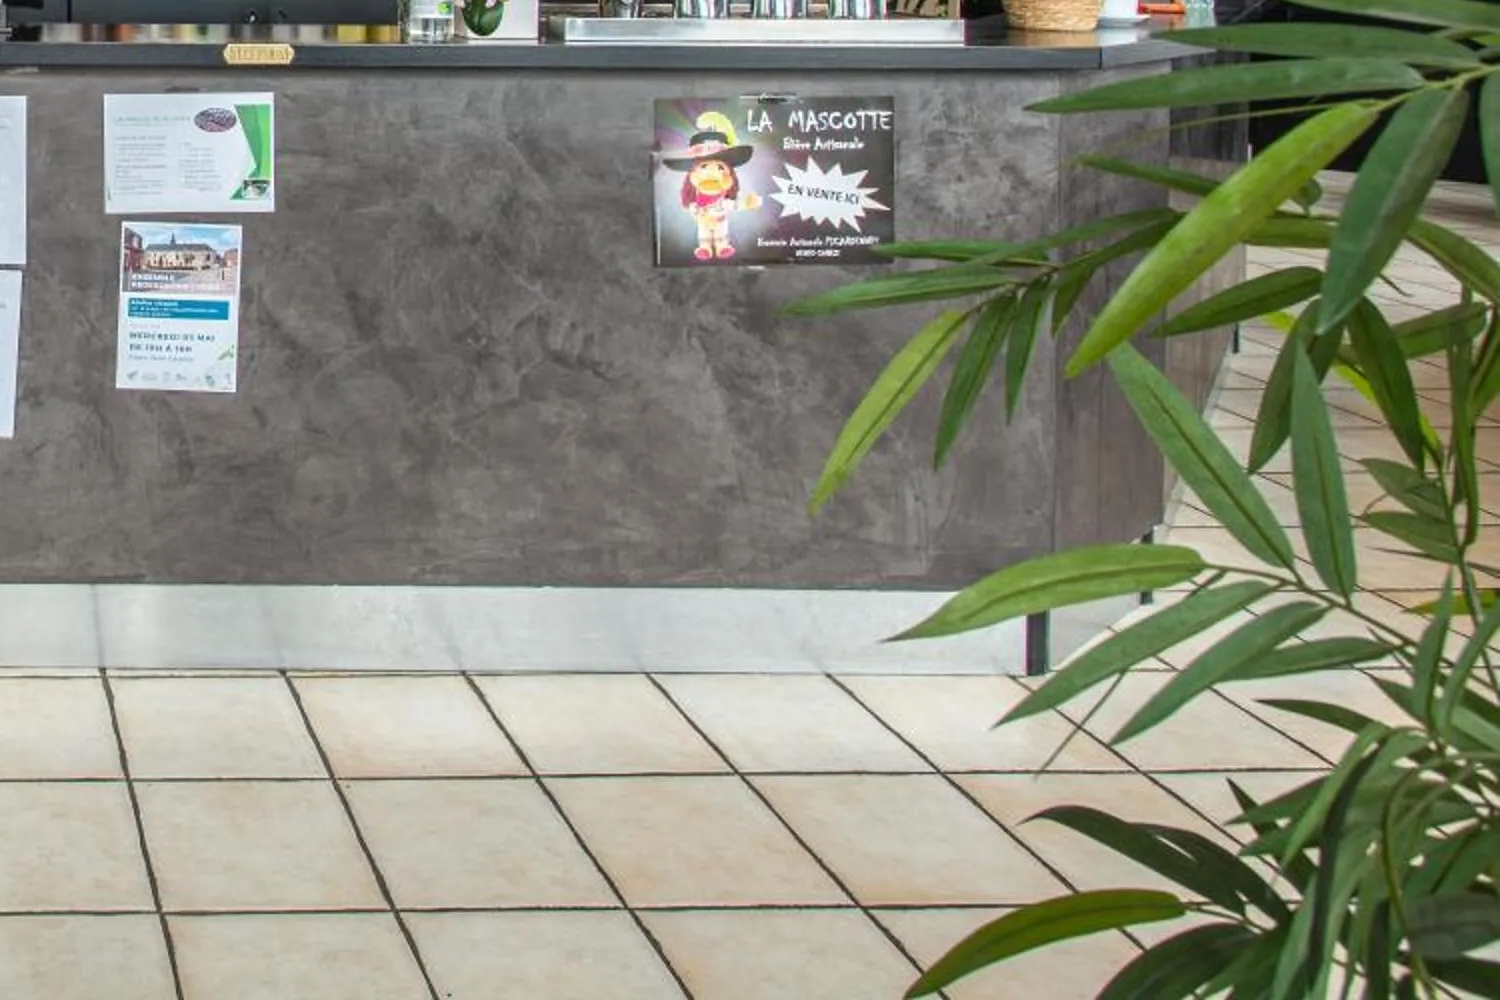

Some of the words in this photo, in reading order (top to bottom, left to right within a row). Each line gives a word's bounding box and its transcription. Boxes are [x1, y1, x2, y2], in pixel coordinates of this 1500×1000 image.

[747, 109, 773, 133] LA
[787, 109, 893, 133] MASCOTTE
[787, 183, 803, 197] EN
[806, 187, 845, 203] VENTE
[845, 192, 860, 205] ICI
